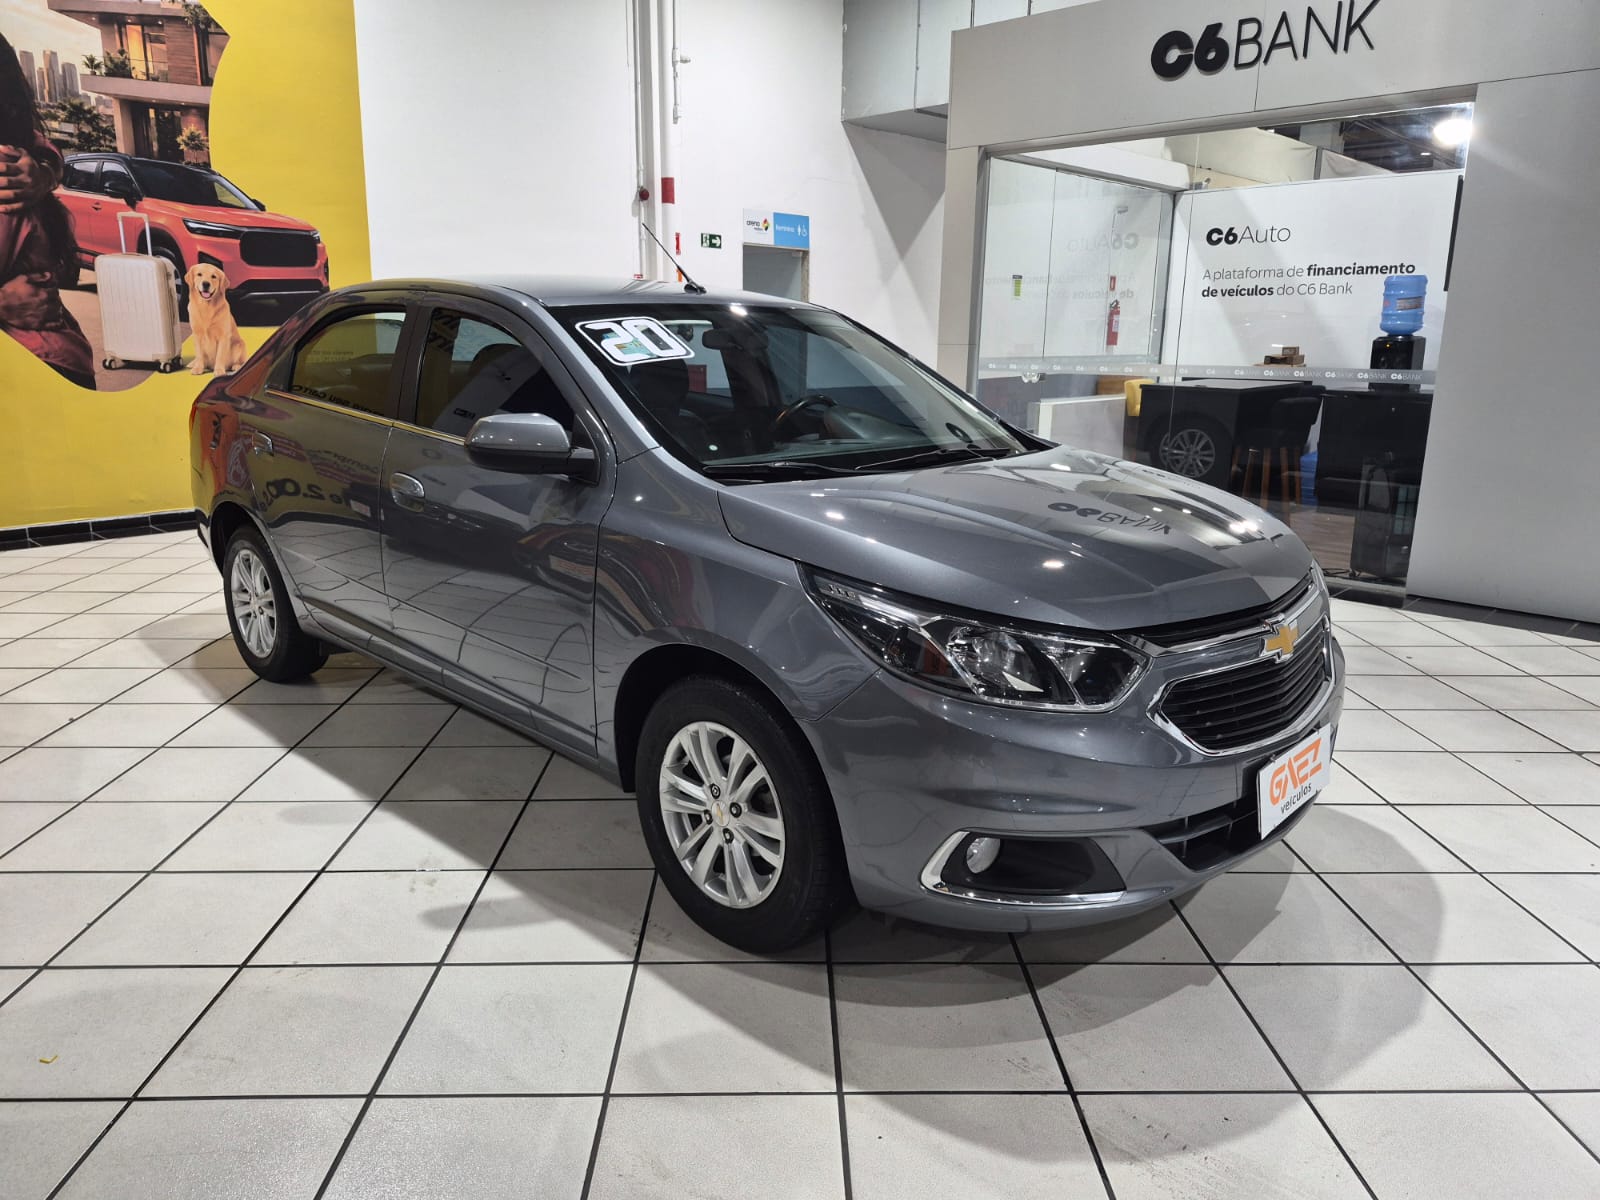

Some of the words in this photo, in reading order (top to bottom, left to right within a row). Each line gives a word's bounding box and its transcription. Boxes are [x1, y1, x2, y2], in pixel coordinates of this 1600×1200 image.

[1206, 225, 1291, 246] C6Auto
[1213, 265, 1284, 281] plataforma
[1286, 264, 1304, 278] de
[1306, 262, 1416, 277] financiamento
[1201, 286, 1218, 298] de
[1220, 284, 1274, 297] veículos
[1276, 283, 1295, 296] do
[1297, 283, 1316, 296] C6
[1319, 282, 1353, 296] Bank
[584, 318, 687, 362] 20
